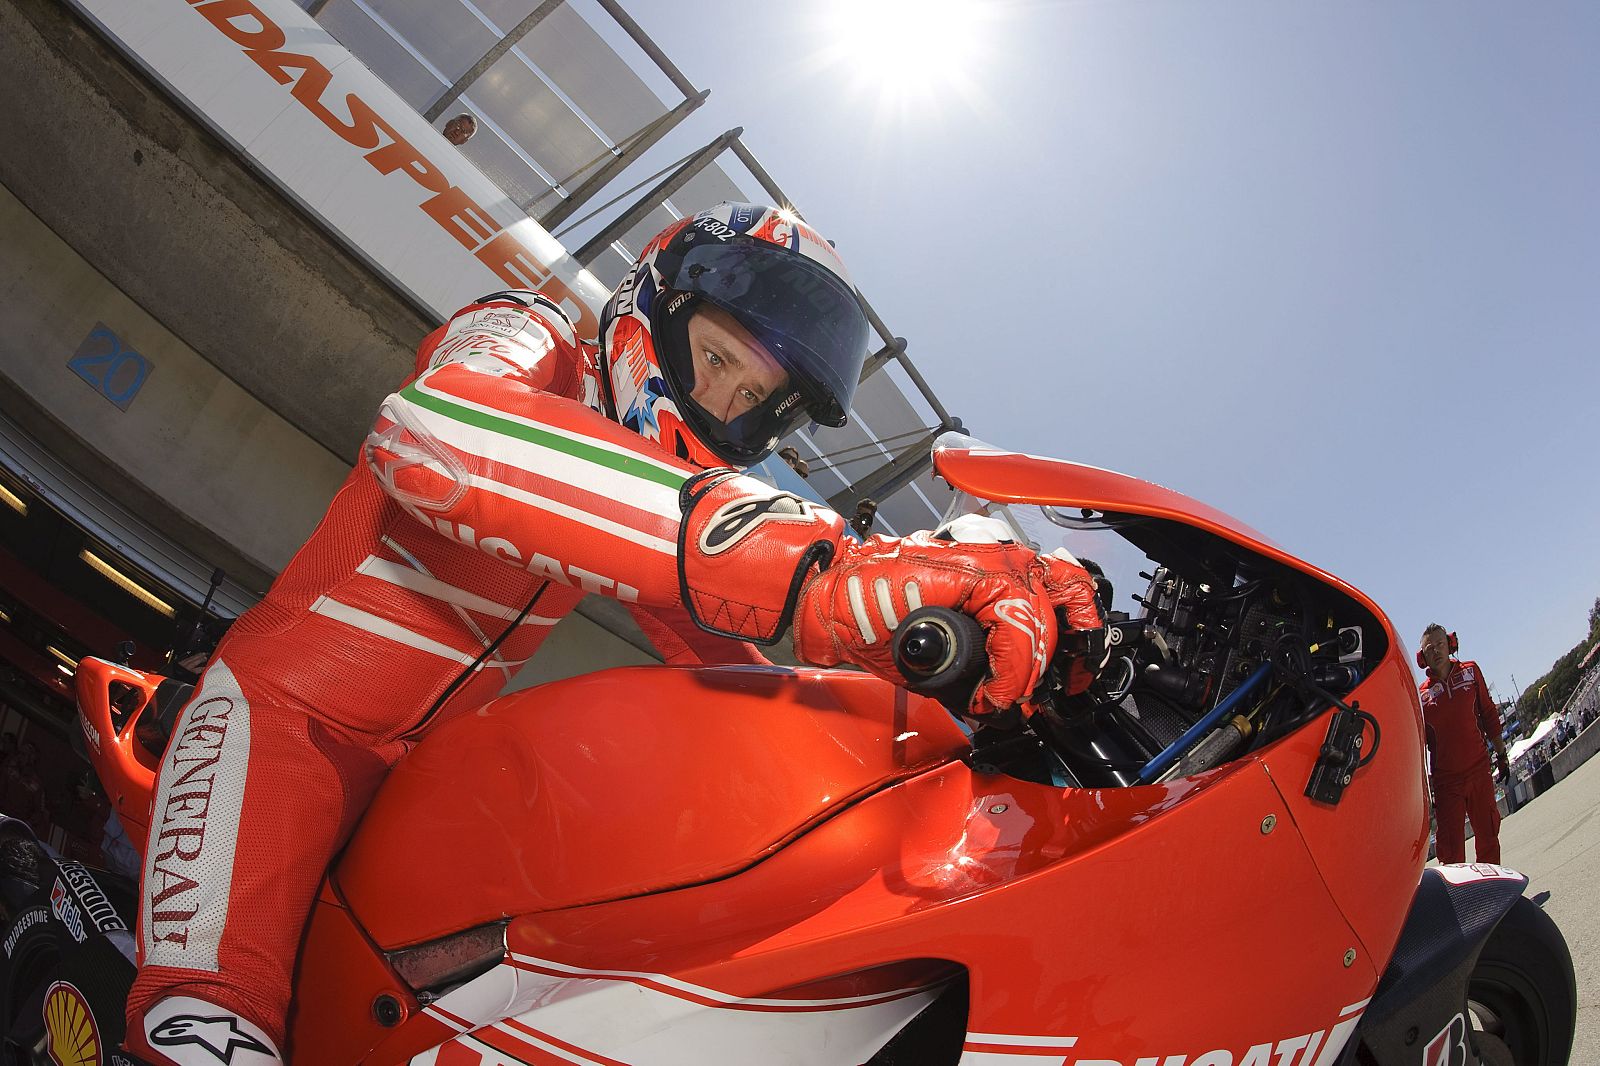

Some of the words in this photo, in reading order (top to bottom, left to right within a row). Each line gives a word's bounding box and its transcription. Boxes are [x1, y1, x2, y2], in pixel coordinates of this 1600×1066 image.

[184, 0, 599, 341] DASPEED
[694, 217, 737, 242] X-802
[667, 292, 697, 315] OLAN
[69, 328, 146, 405] 20
[774, 391, 802, 417] NOLAN
[57, 860, 128, 932] GESTONE
[3, 909, 49, 960] BRIDGESTONE
